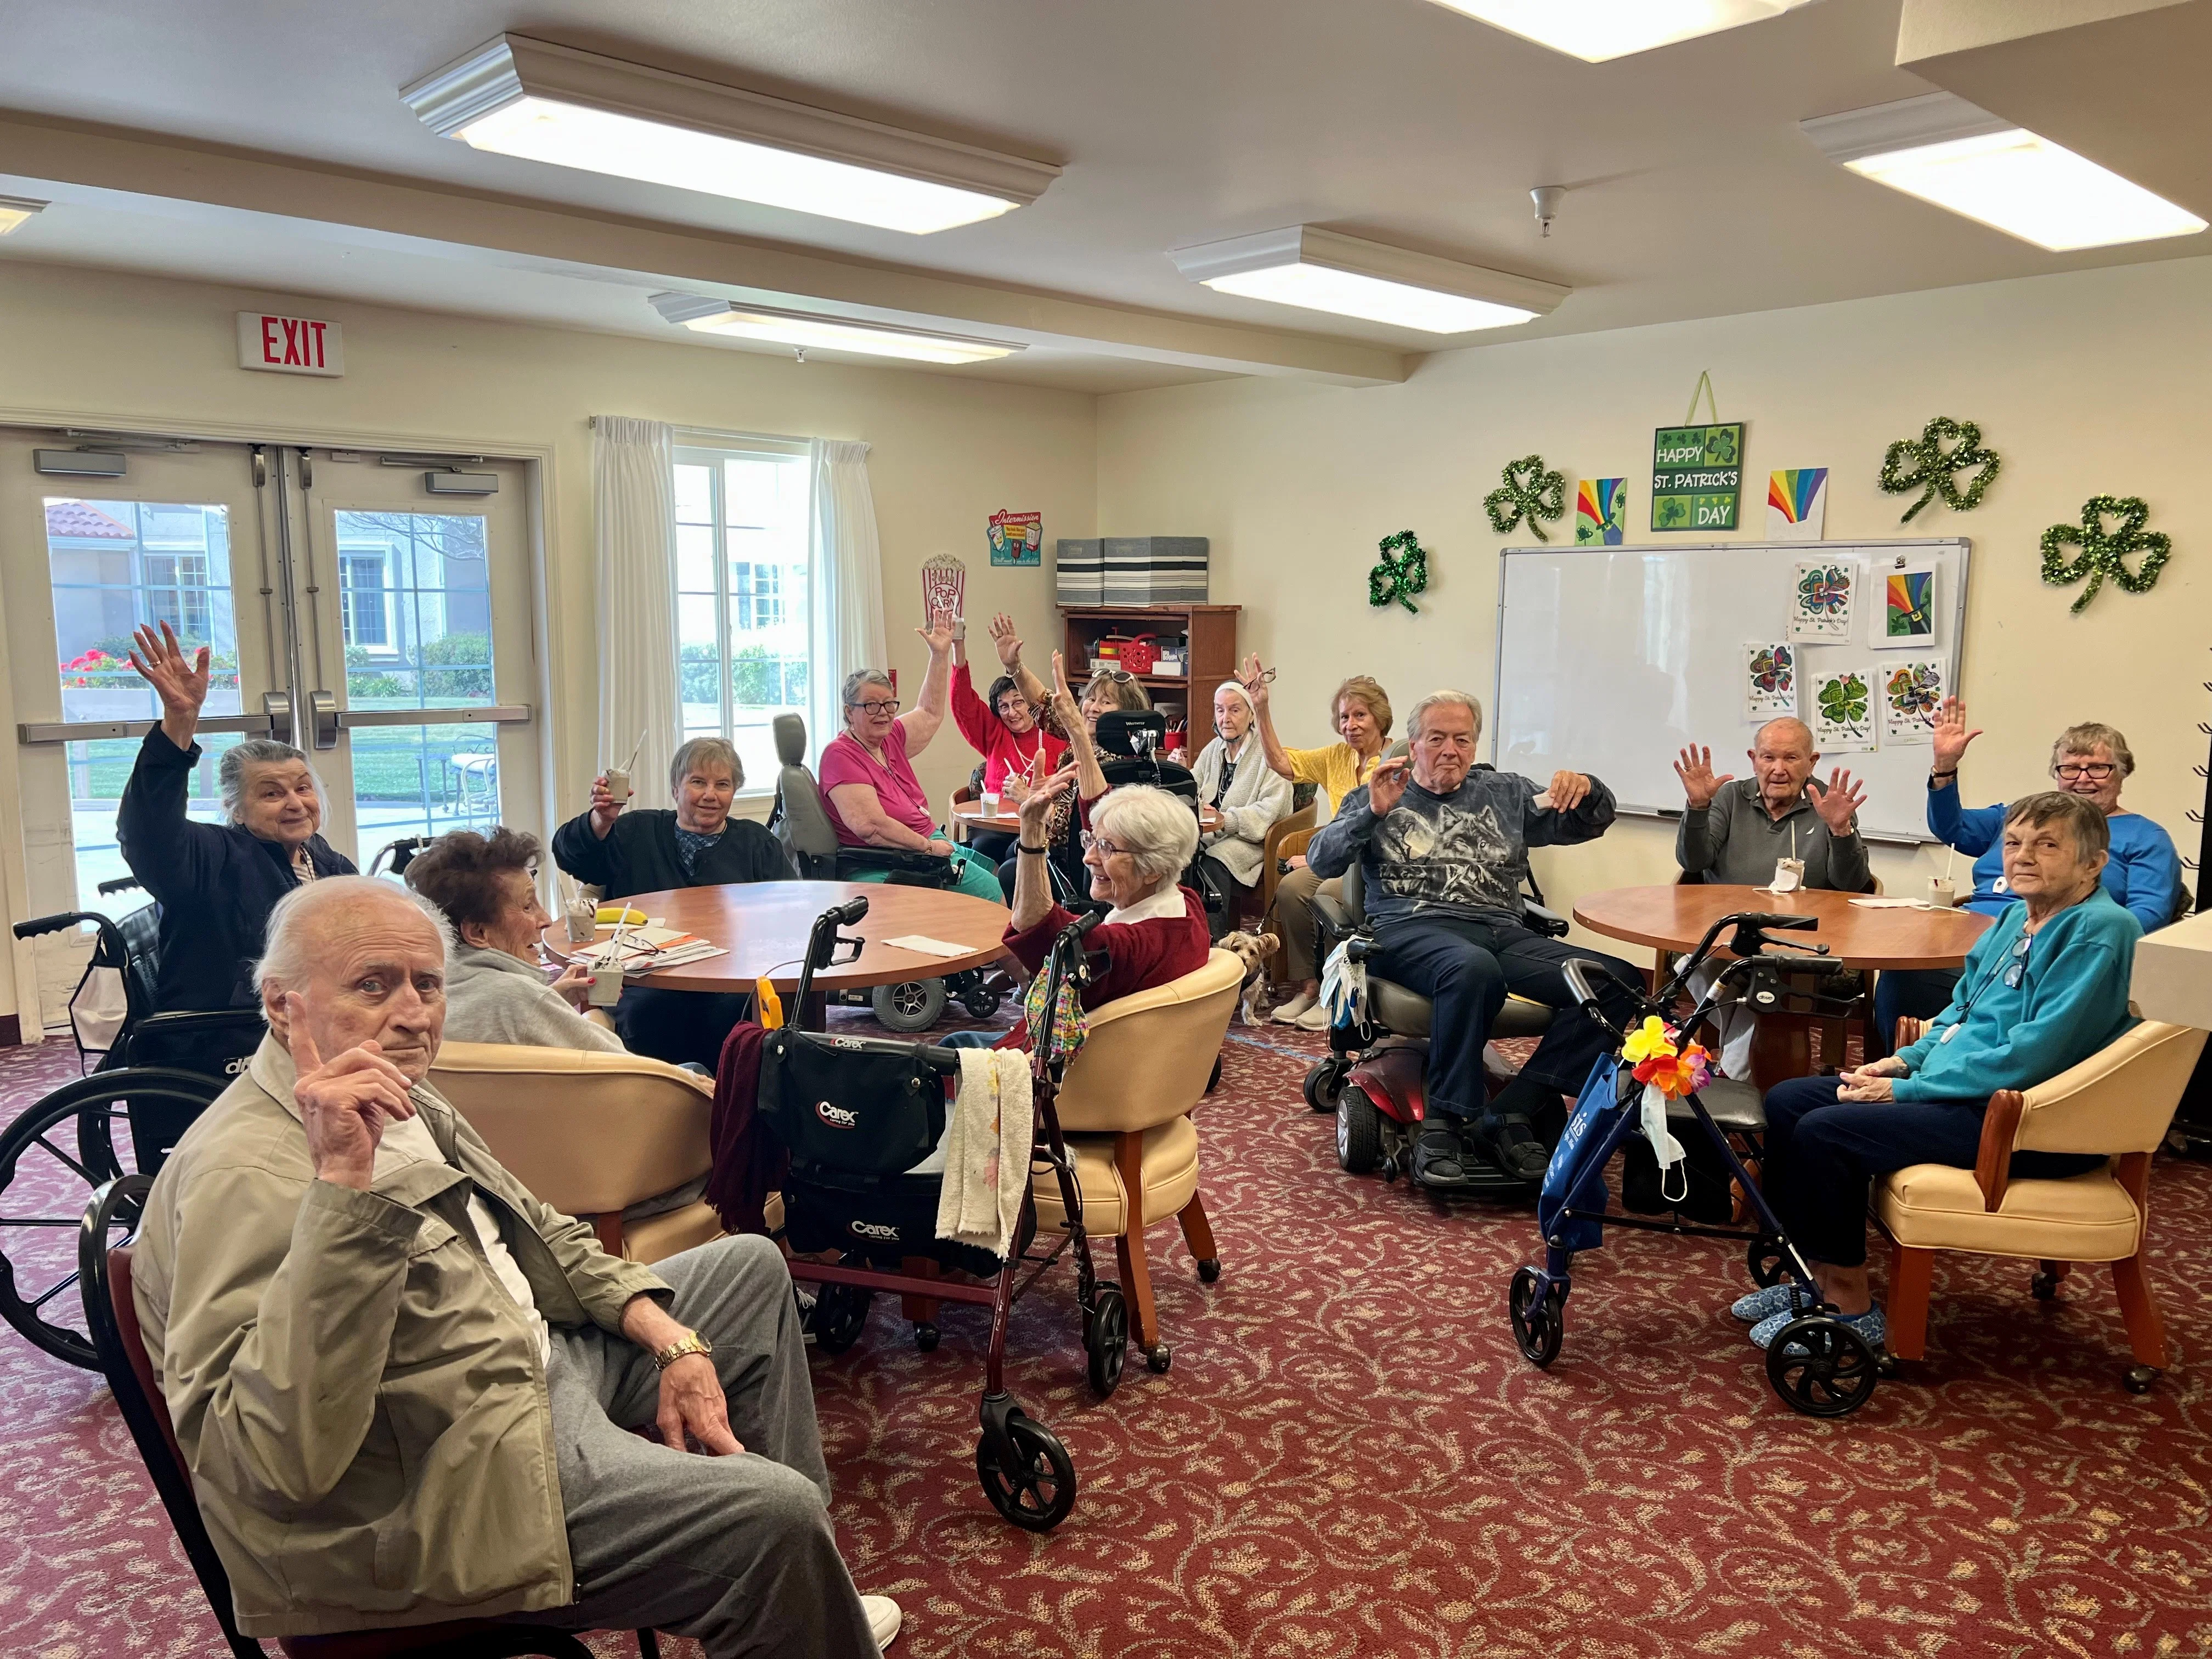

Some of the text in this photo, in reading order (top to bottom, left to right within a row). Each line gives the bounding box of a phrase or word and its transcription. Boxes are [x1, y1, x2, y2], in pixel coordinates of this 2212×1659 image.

[262, 317, 326, 368] EXIT
[1657, 446, 1703, 462] HAPPY
[1655, 471, 1738, 489] ST. PATRICK'S
[995, 511, 1040, 524] Intermission
[1698, 505, 1730, 525] DAY
[935, 586, 956, 599] POP
[835, 1037, 864, 1049] Carex
[820, 1102, 855, 1122] Carex
[852, 1221, 899, 1237] Carex
